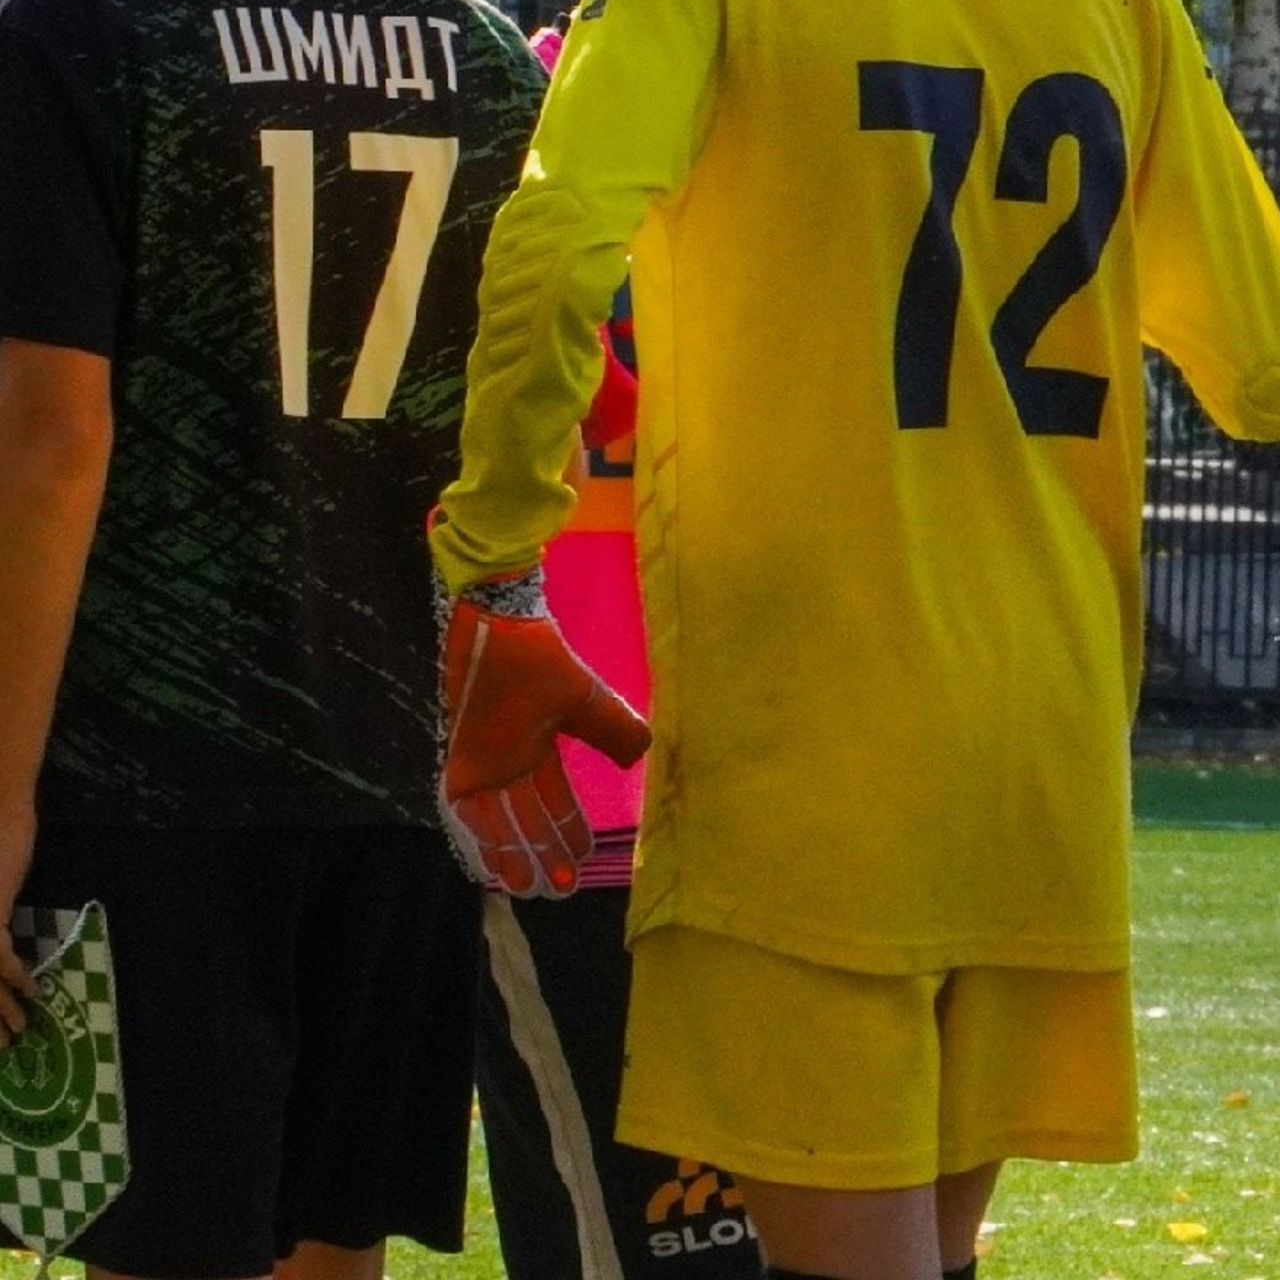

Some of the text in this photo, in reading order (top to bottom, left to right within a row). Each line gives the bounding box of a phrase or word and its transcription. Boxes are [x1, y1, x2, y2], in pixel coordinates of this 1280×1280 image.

[212, 7, 460, 100] ШМИДТ
[260, 129, 460, 420] 17
[857, 60, 1129, 440] 72
